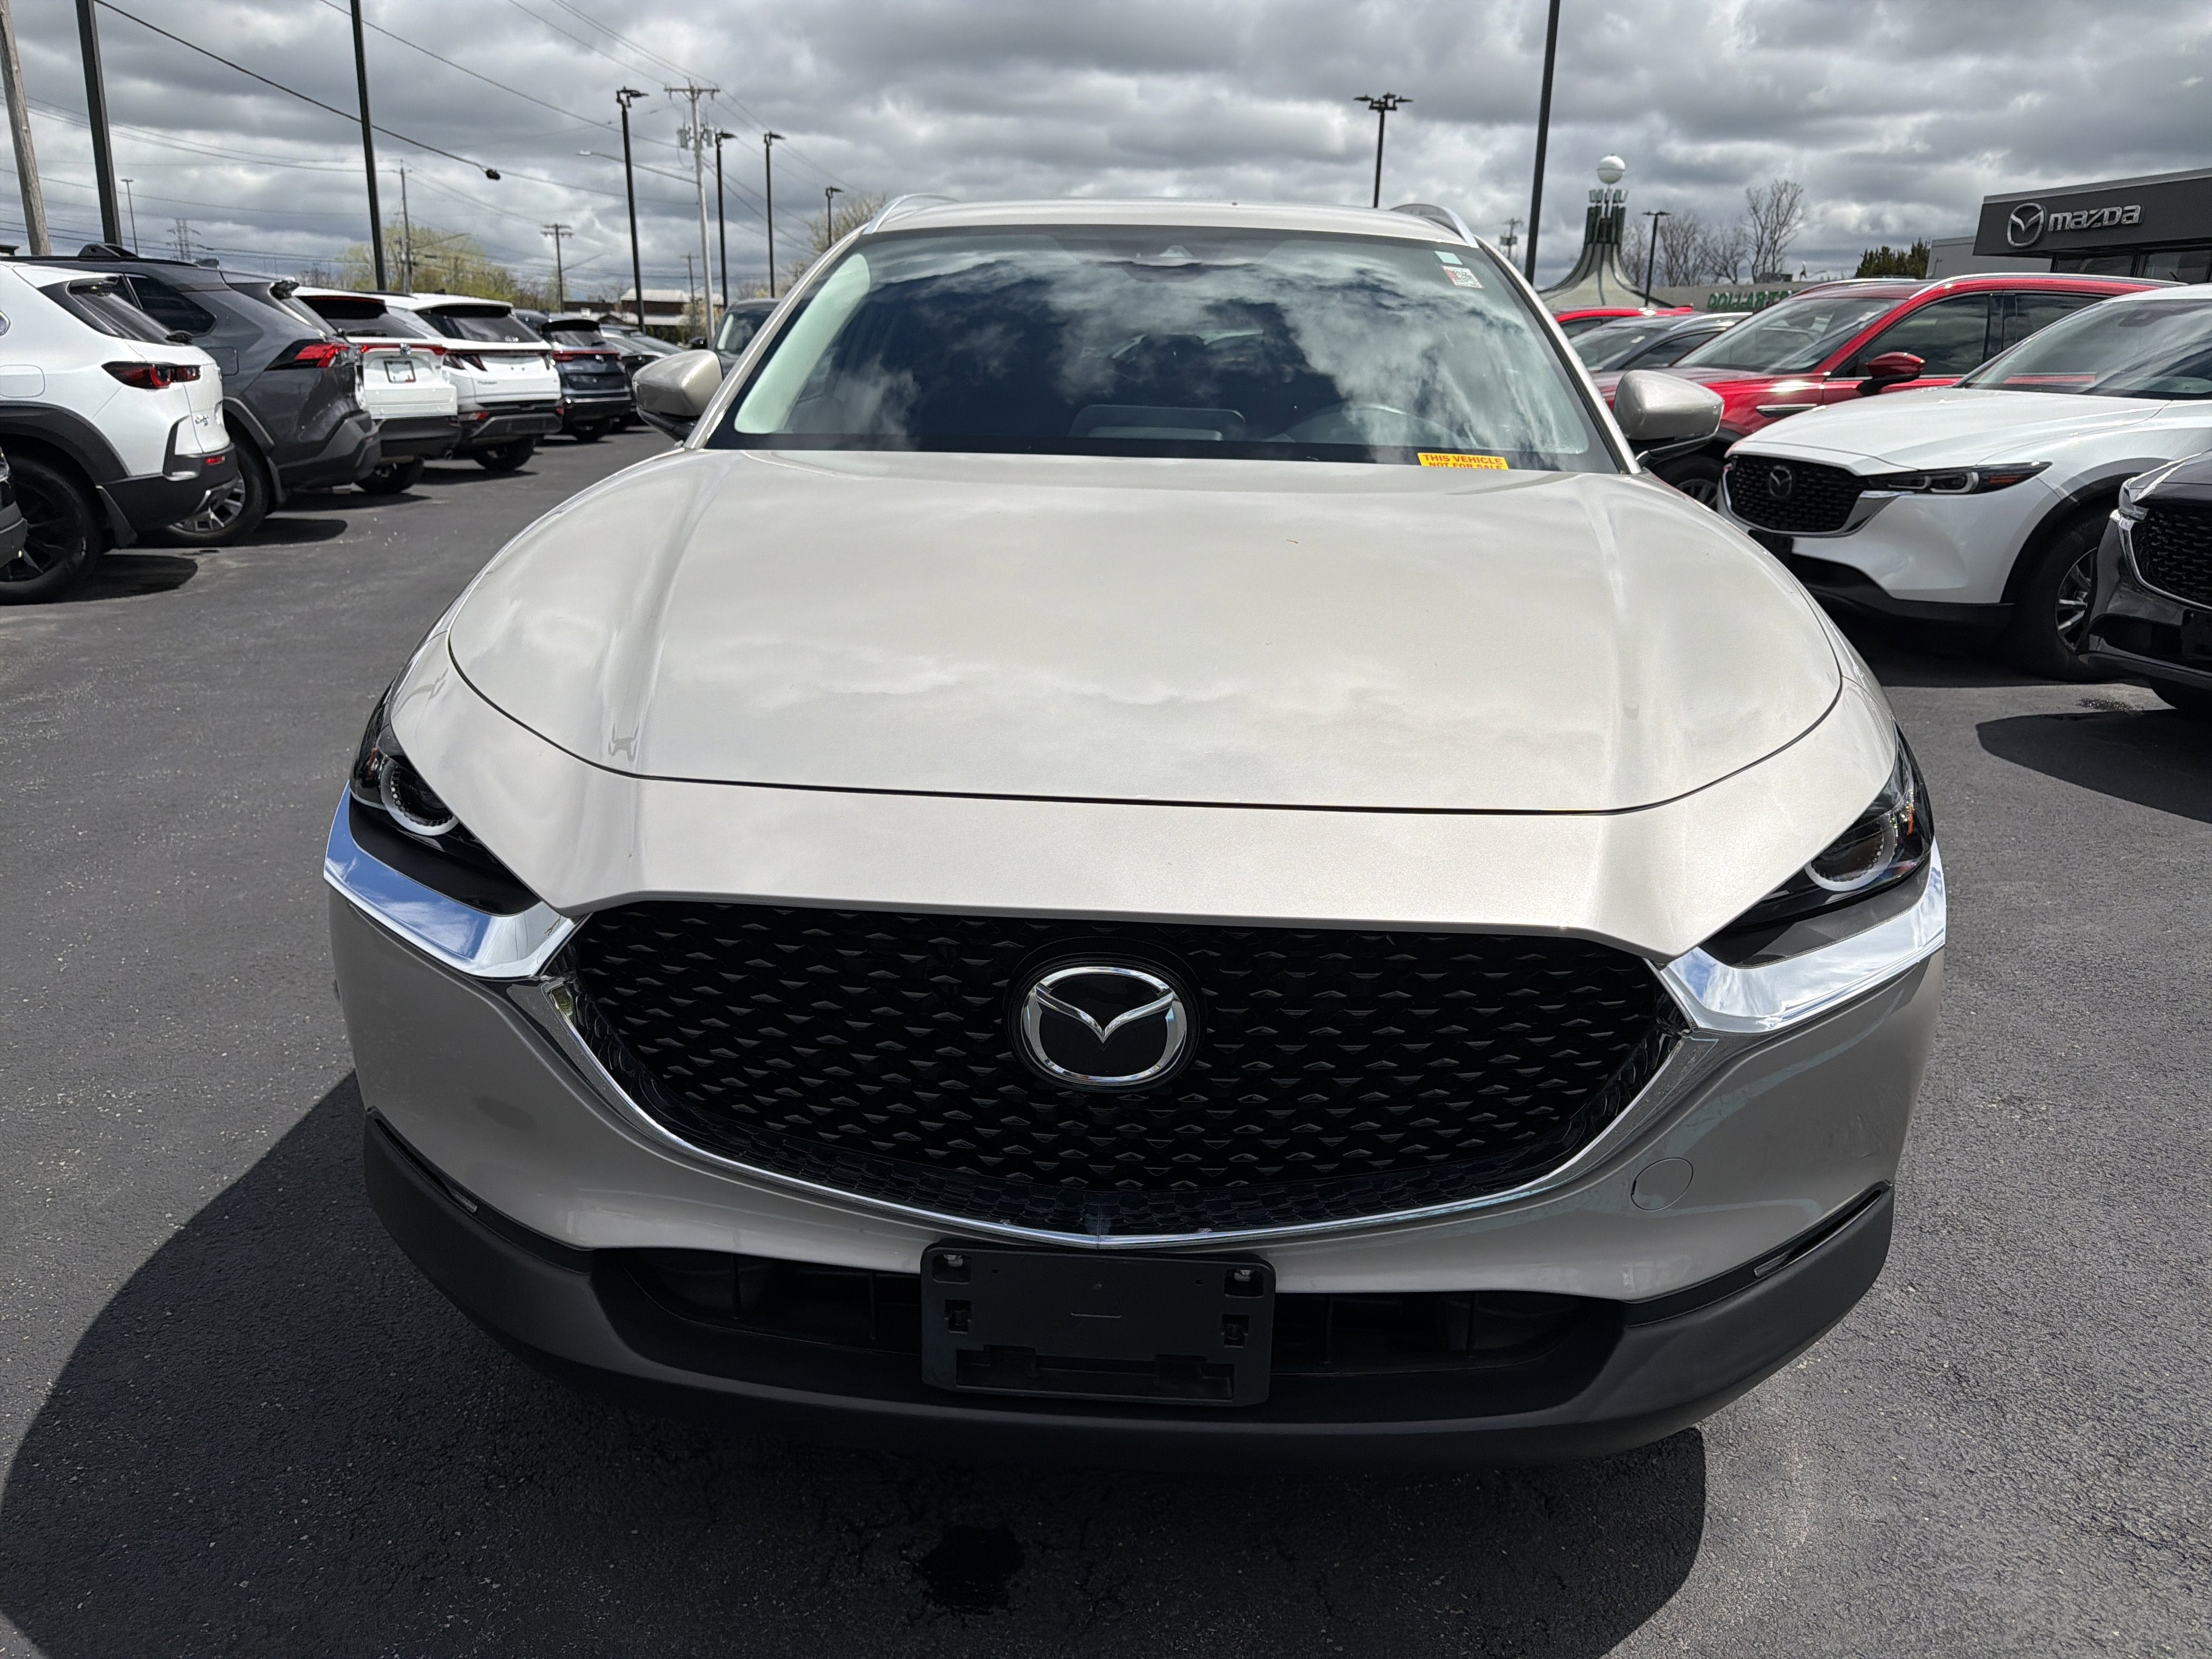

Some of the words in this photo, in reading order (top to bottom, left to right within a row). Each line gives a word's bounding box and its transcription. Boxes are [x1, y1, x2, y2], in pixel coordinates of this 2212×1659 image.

[2047, 205, 2141, 232] mazda
[1707, 291, 1766, 309] DOLLAR
[1453, 455, 1502, 465] VEHICLE
